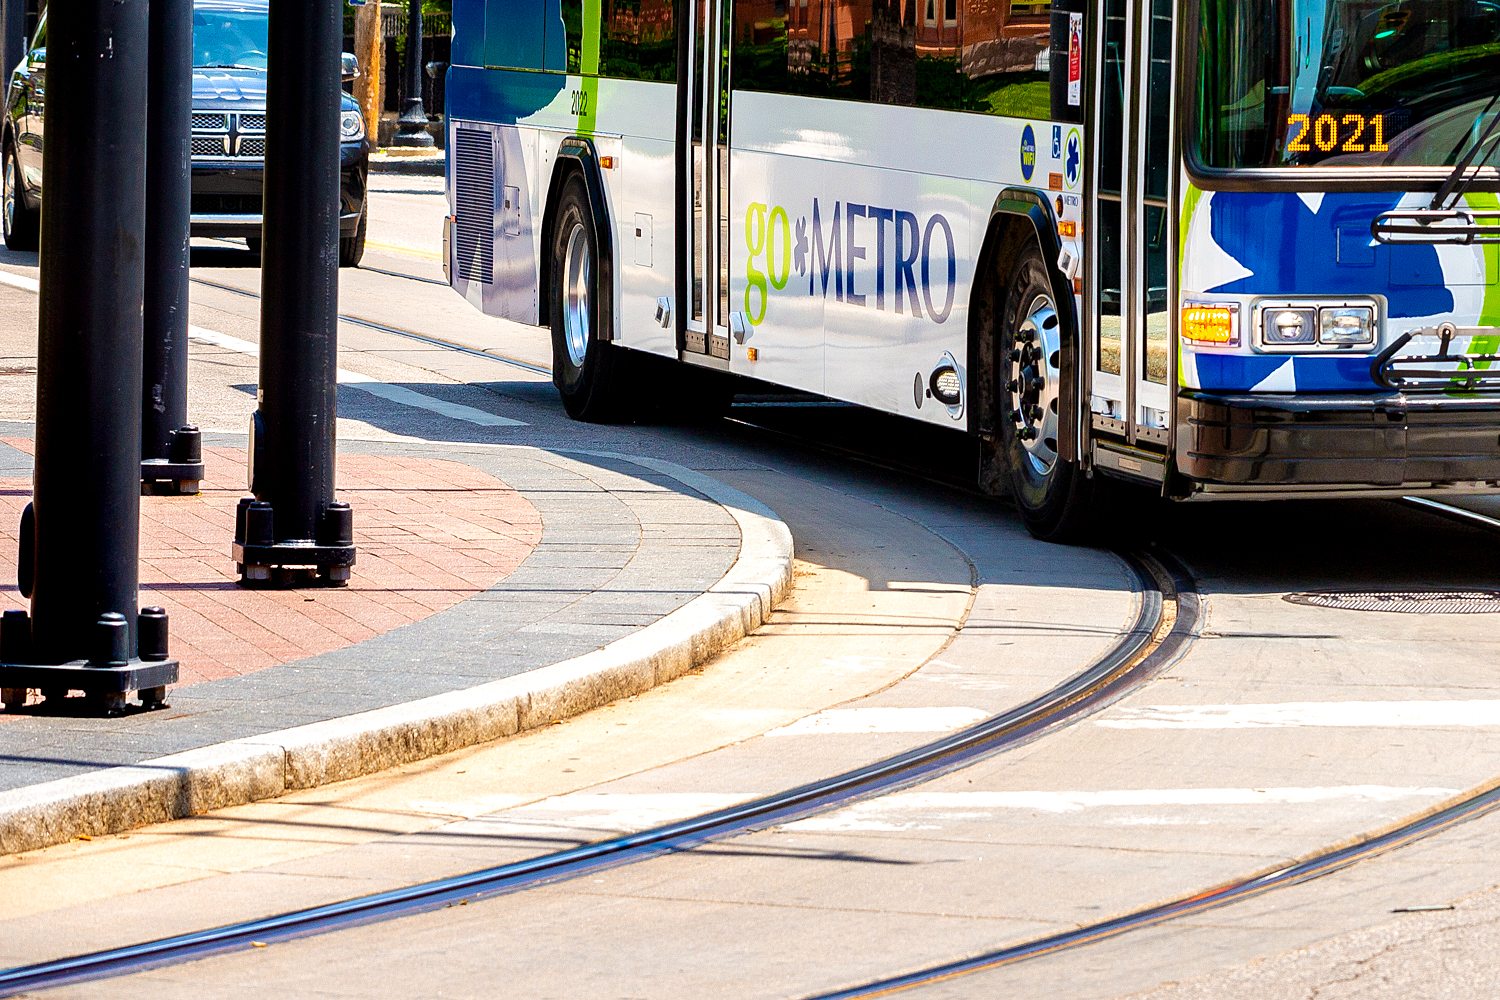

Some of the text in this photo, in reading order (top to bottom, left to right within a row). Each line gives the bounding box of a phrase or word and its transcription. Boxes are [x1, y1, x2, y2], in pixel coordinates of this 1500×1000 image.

[571, 90, 588, 116] 2022
[1287, 113, 1389, 152] 2021
[744, 201, 792, 326] go
[809, 197, 957, 325] METRO
